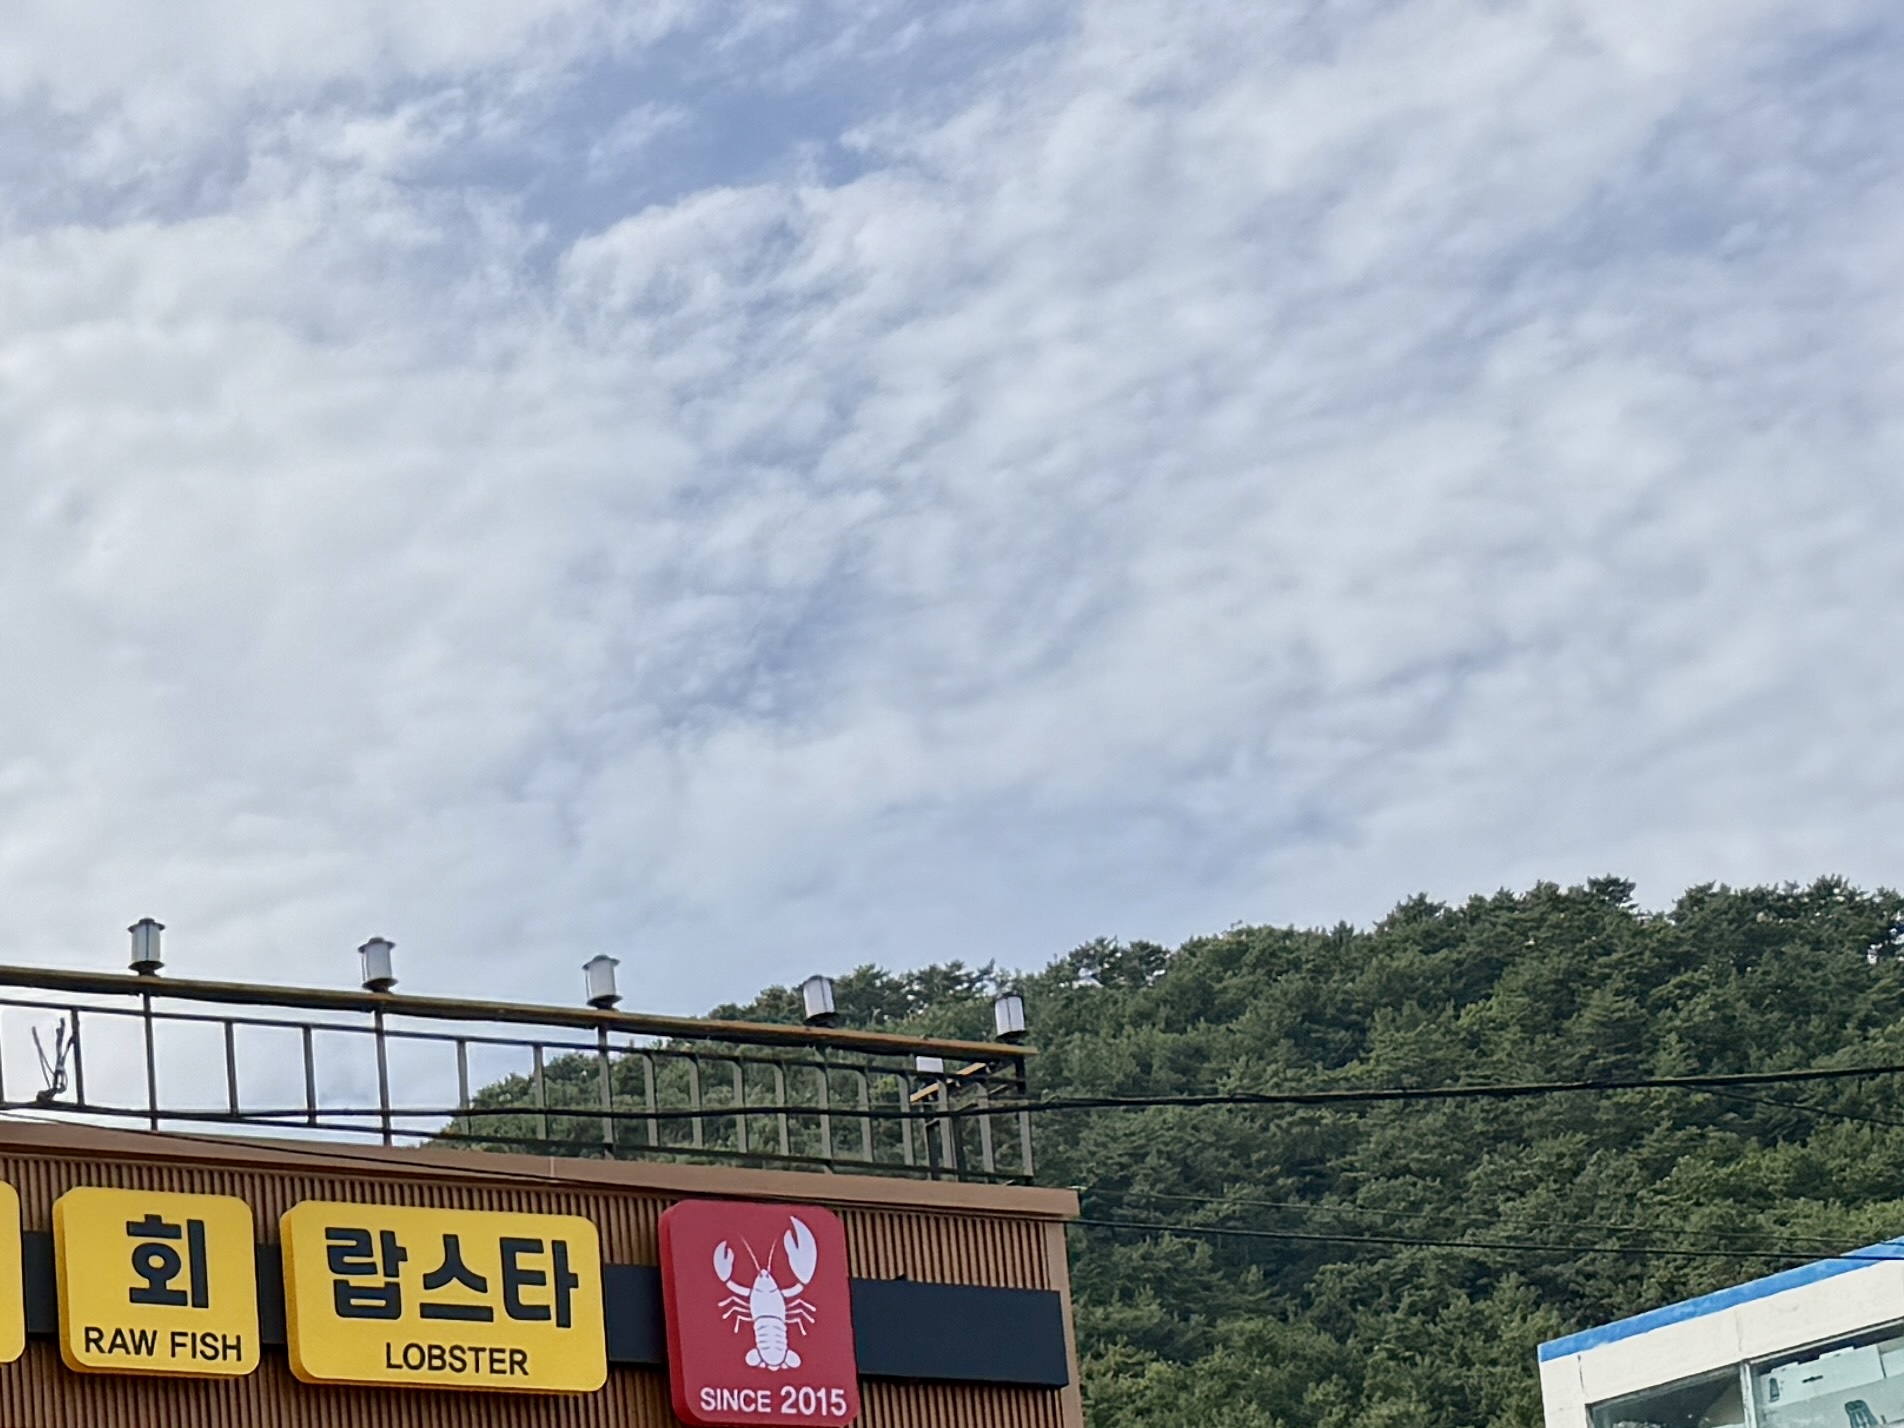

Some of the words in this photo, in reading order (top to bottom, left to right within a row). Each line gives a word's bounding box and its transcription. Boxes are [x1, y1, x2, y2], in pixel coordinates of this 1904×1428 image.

[124, 1213, 210, 1309] 회
[324, 1223, 581, 1329] 랍스타
[82, 1324, 159, 1356] RAW
[168, 1329, 244, 1363] FISH
[385, 1341, 531, 1377] LOBSTER
[699, 1385, 773, 1414] SINCE
[778, 1385, 848, 1418] 2015
